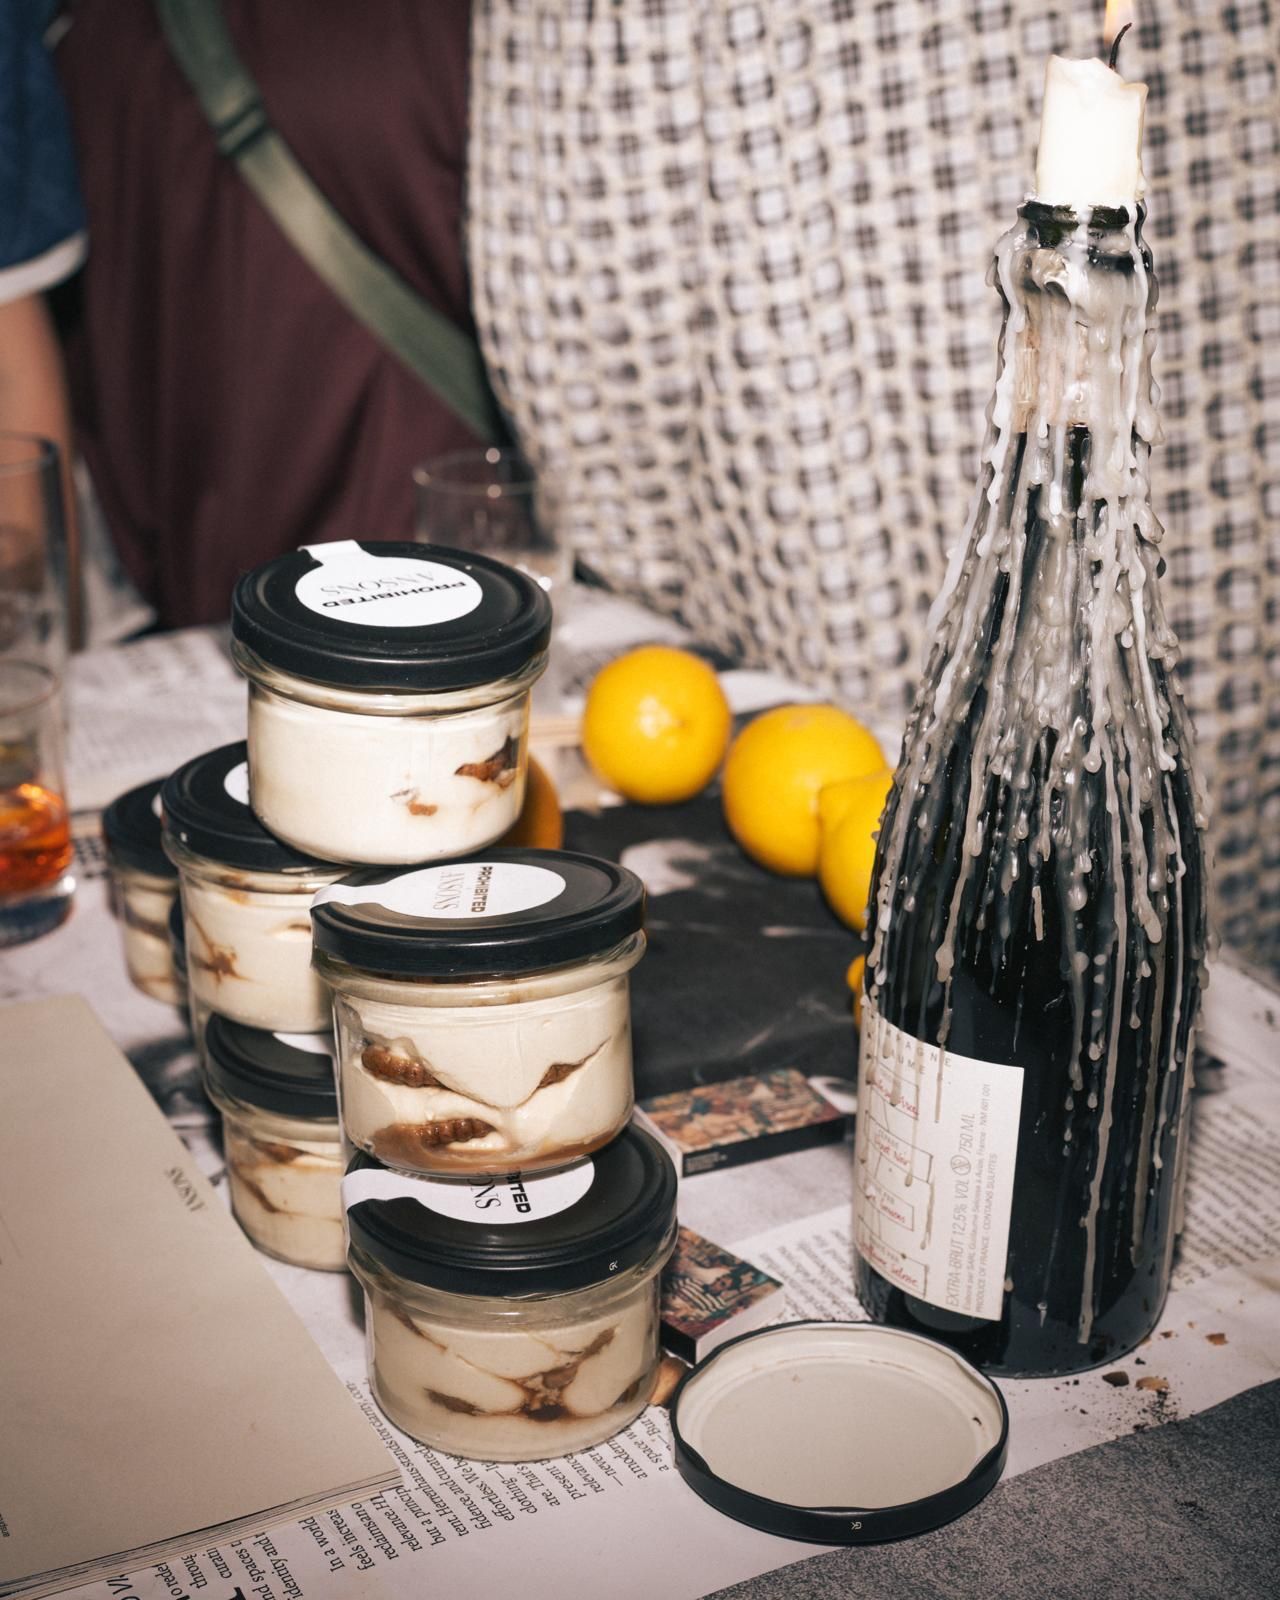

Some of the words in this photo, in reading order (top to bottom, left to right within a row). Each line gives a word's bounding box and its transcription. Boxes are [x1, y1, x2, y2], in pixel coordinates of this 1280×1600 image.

[320, 571, 435, 596] ANSONS
[322, 581, 466, 608] PROHIBITED
[432, 871, 466, 911] ANSONS
[470, 865, 493, 913] PROHIBITED
[961, 1112, 975, 1132] ML
[960, 1132, 973, 1154] 750
[955, 1177, 969, 1200] VOL
[386, 1440, 414, 1471] stands
[415, 1448, 451, 1480] curated
[634, 1441, 662, 1463] space
[440, 1480, 464, 1495] and
[461, 1467, 479, 1483] We
[517, 1466, 544, 1490] That's
[546, 1466, 587, 1500] present
[399, 1467, 454, 1517] Herrenhaus
[476, 1482, 515, 1521] effortless.
[542, 1489, 560, 1506] are.
[460, 1494, 493, 1529] fidence,
[299, 1518, 329, 1547] world
[384, 1509, 423, 1551] relevance.
[426, 1527, 446, 1545] but
[448, 1515, 469, 1536] tent.
[253, 1537, 278, 1557] and
[324, 1548, 335, 1556] a
[364, 1521, 399, 1560] reclaims
[236, 1549, 266, 1582] spaces
[330, 1557, 345, 1571] In
[349, 1545, 375, 1570] feels
[271, 1559, 303, 1600] identity
